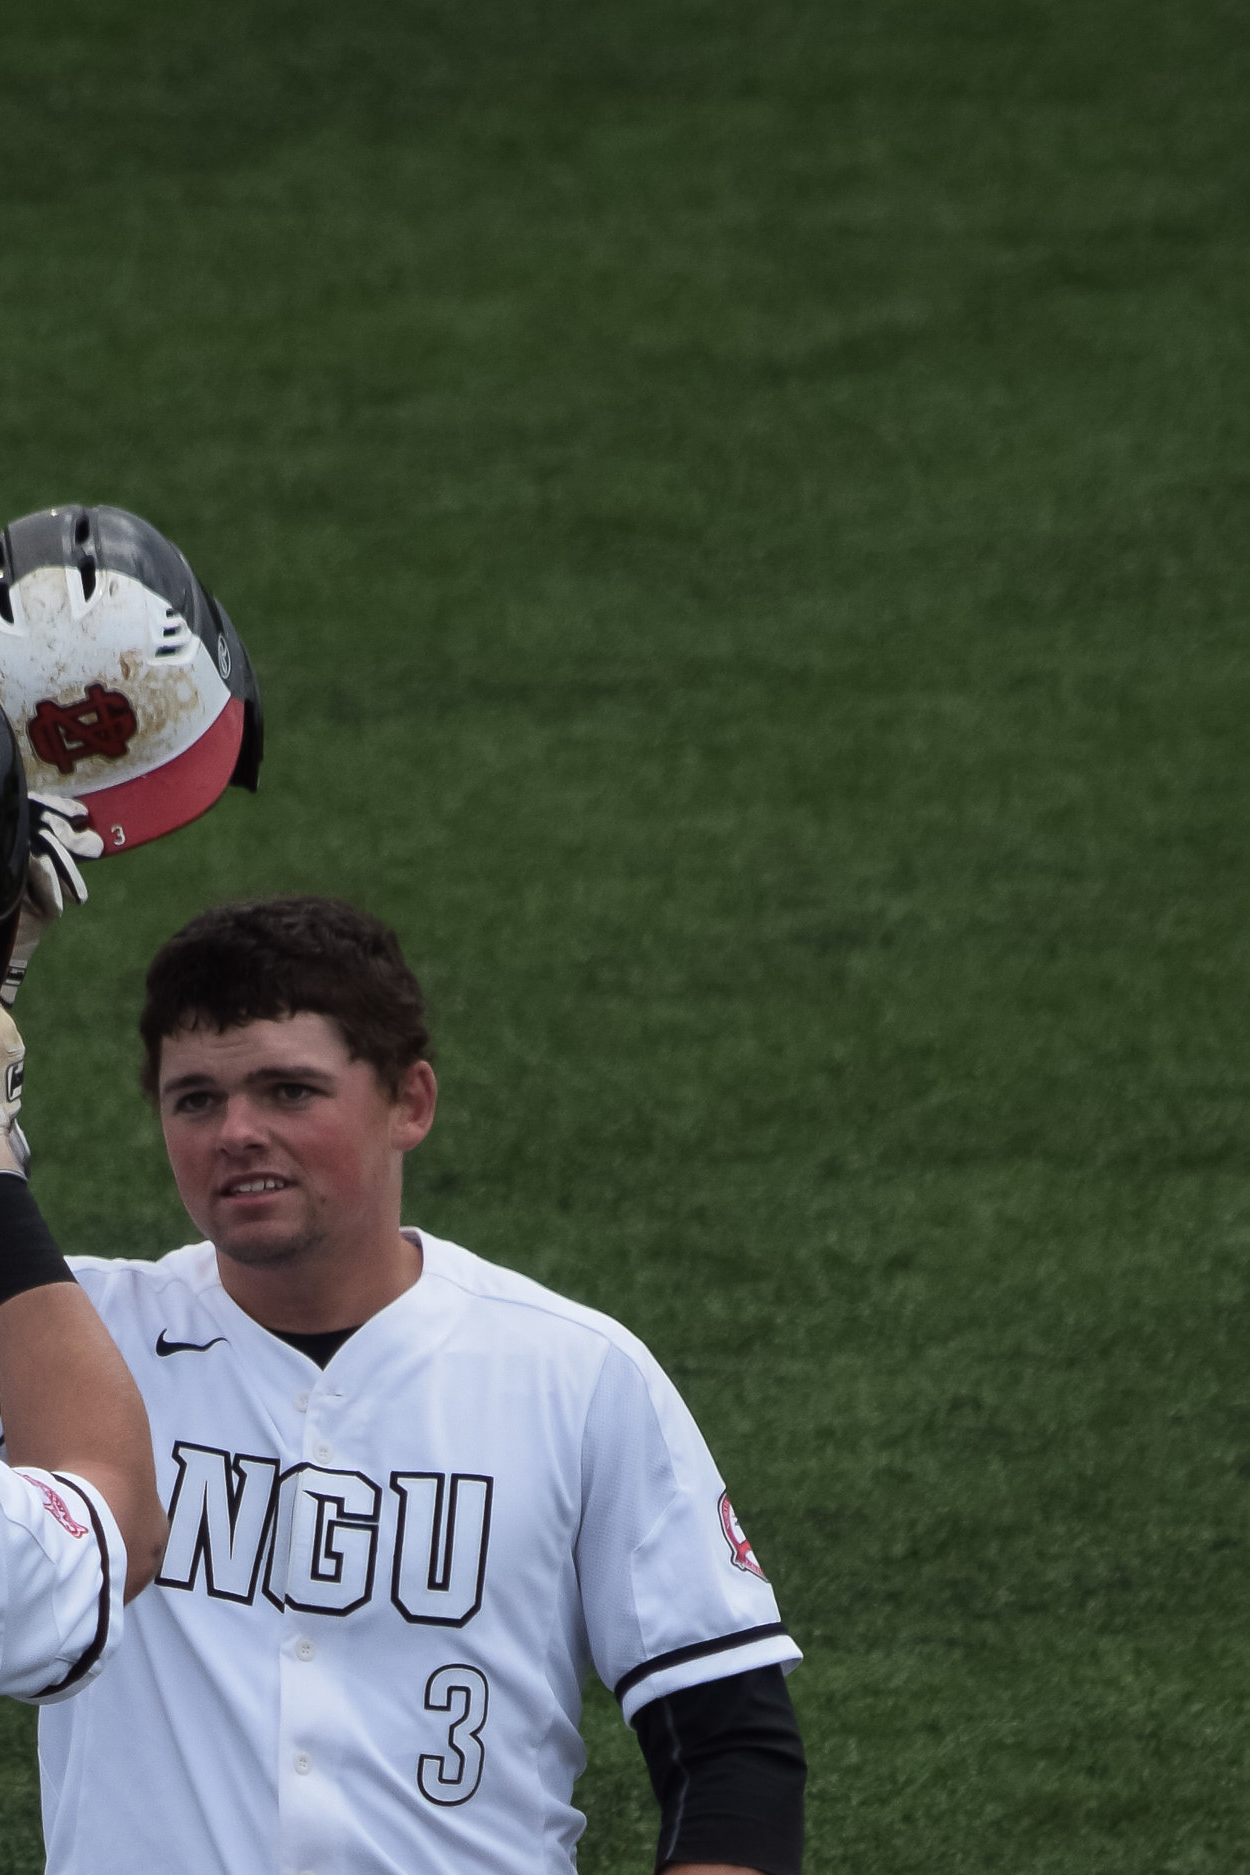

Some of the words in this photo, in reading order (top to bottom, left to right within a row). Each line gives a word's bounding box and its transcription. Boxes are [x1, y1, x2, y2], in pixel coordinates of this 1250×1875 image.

[111, 824, 126, 846] 3
[154, 1440, 494, 1629] NGU
[417, 1663, 489, 1807] 3
